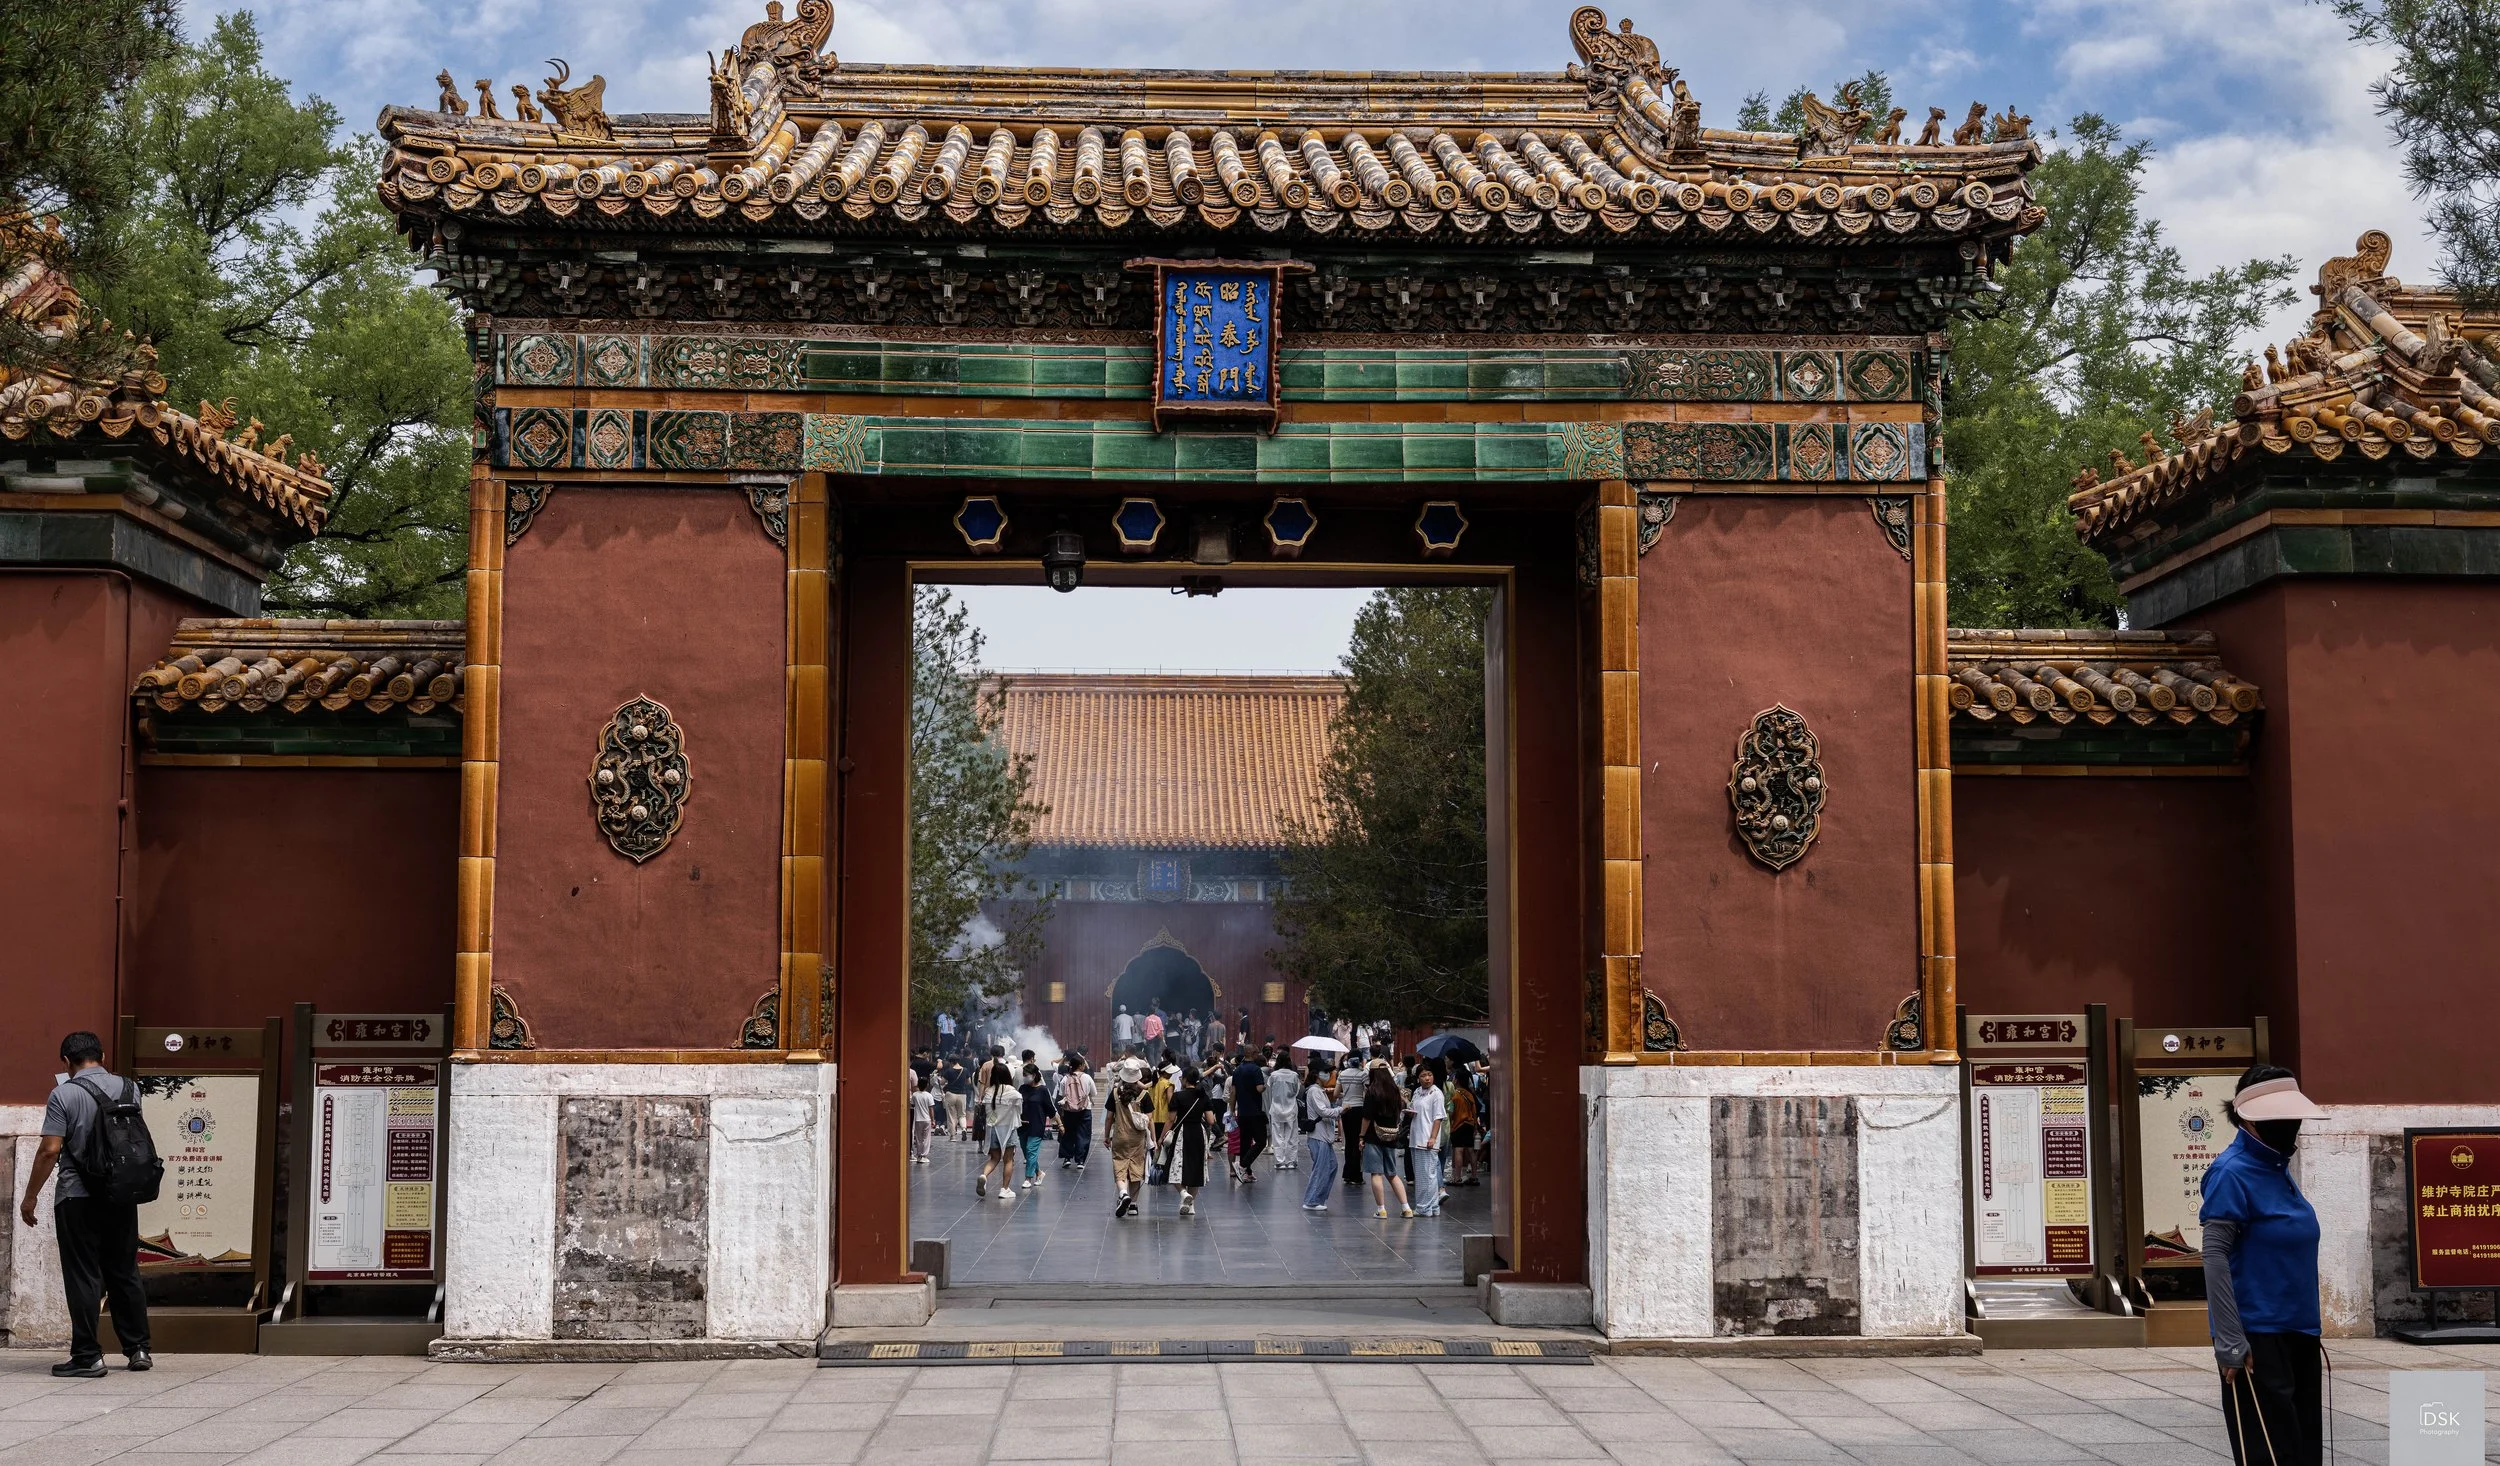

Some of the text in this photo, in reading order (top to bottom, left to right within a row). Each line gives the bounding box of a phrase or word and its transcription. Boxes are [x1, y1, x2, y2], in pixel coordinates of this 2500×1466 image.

[1219, 282, 1241, 392] 昭泰門
[354, 1022, 404, 1039] 雍和宫
[2006, 1023, 2052, 1040] 雍和宫
[187, 1034, 233, 1051] 雍和宫
[2183, 1035, 2226, 1051] 雍和宫
[362, 1066, 394, 1074] 雍和宫
[2014, 1066, 2045, 1074] 雍和宫
[340, 1074, 415, 1083] 消防安全公示牌
[1994, 1074, 2065, 1082] 消防安全公示牌
[187, 1165, 213, 1174] 讲文物
[2421, 1184, 2500, 1198] 维护寺院庄严
[2422, 1203, 2500, 1218] 禁止商拍扰序
